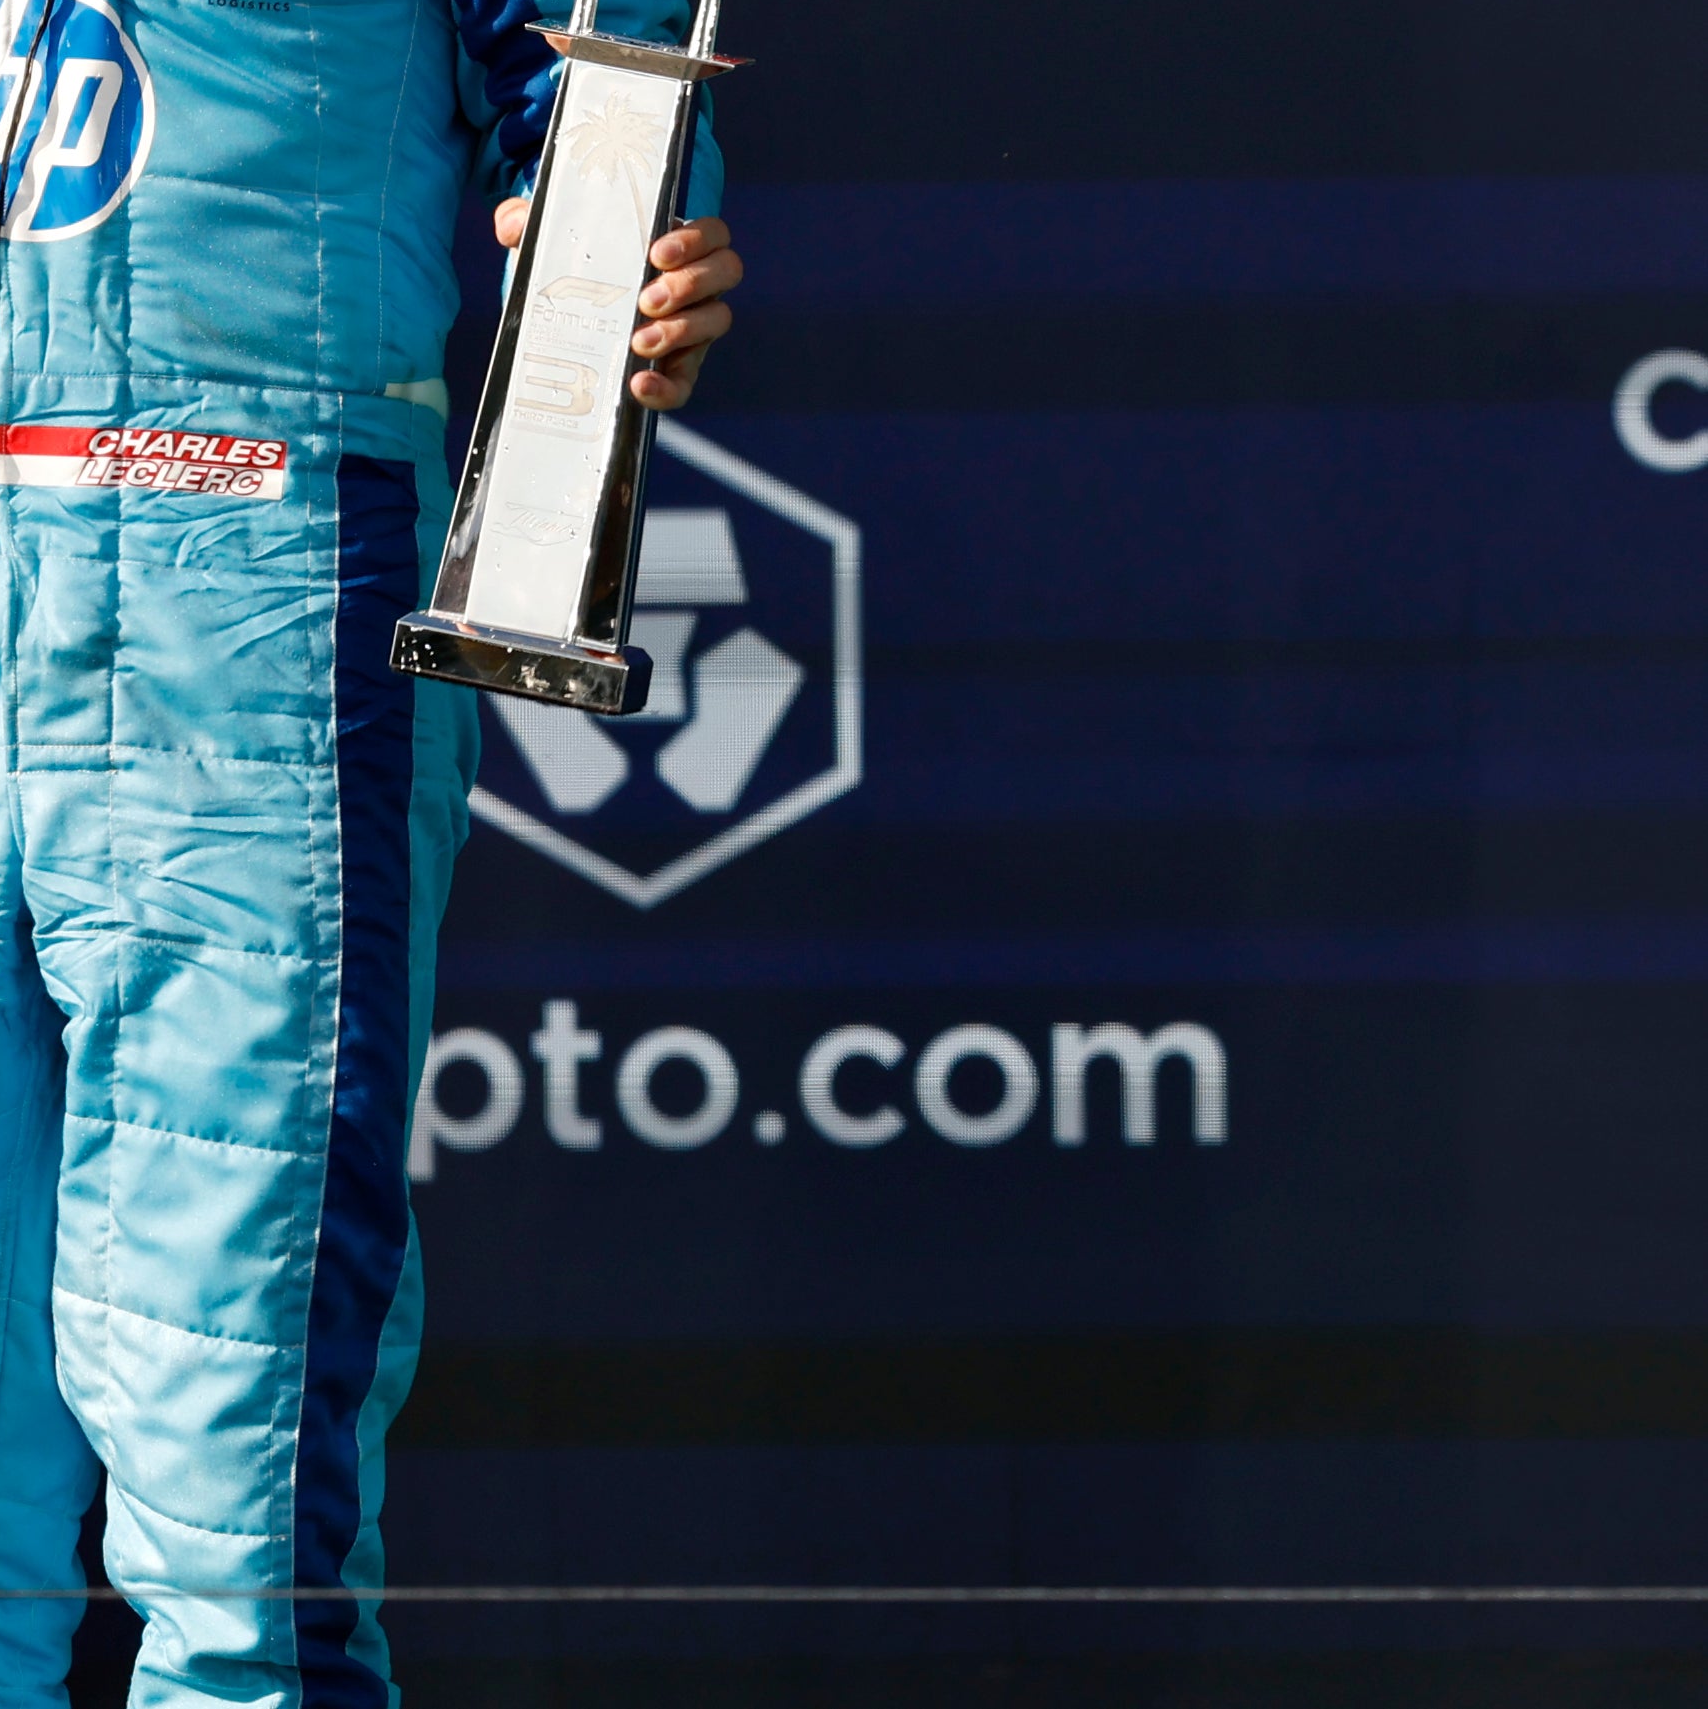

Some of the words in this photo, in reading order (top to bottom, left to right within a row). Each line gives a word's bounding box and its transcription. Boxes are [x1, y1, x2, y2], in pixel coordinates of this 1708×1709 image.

[533, 303, 608, 333] Formula
[514, 352, 600, 417] 3
[88, 429, 282, 468] CHARLES
[76, 457, 266, 496] LECLERC
